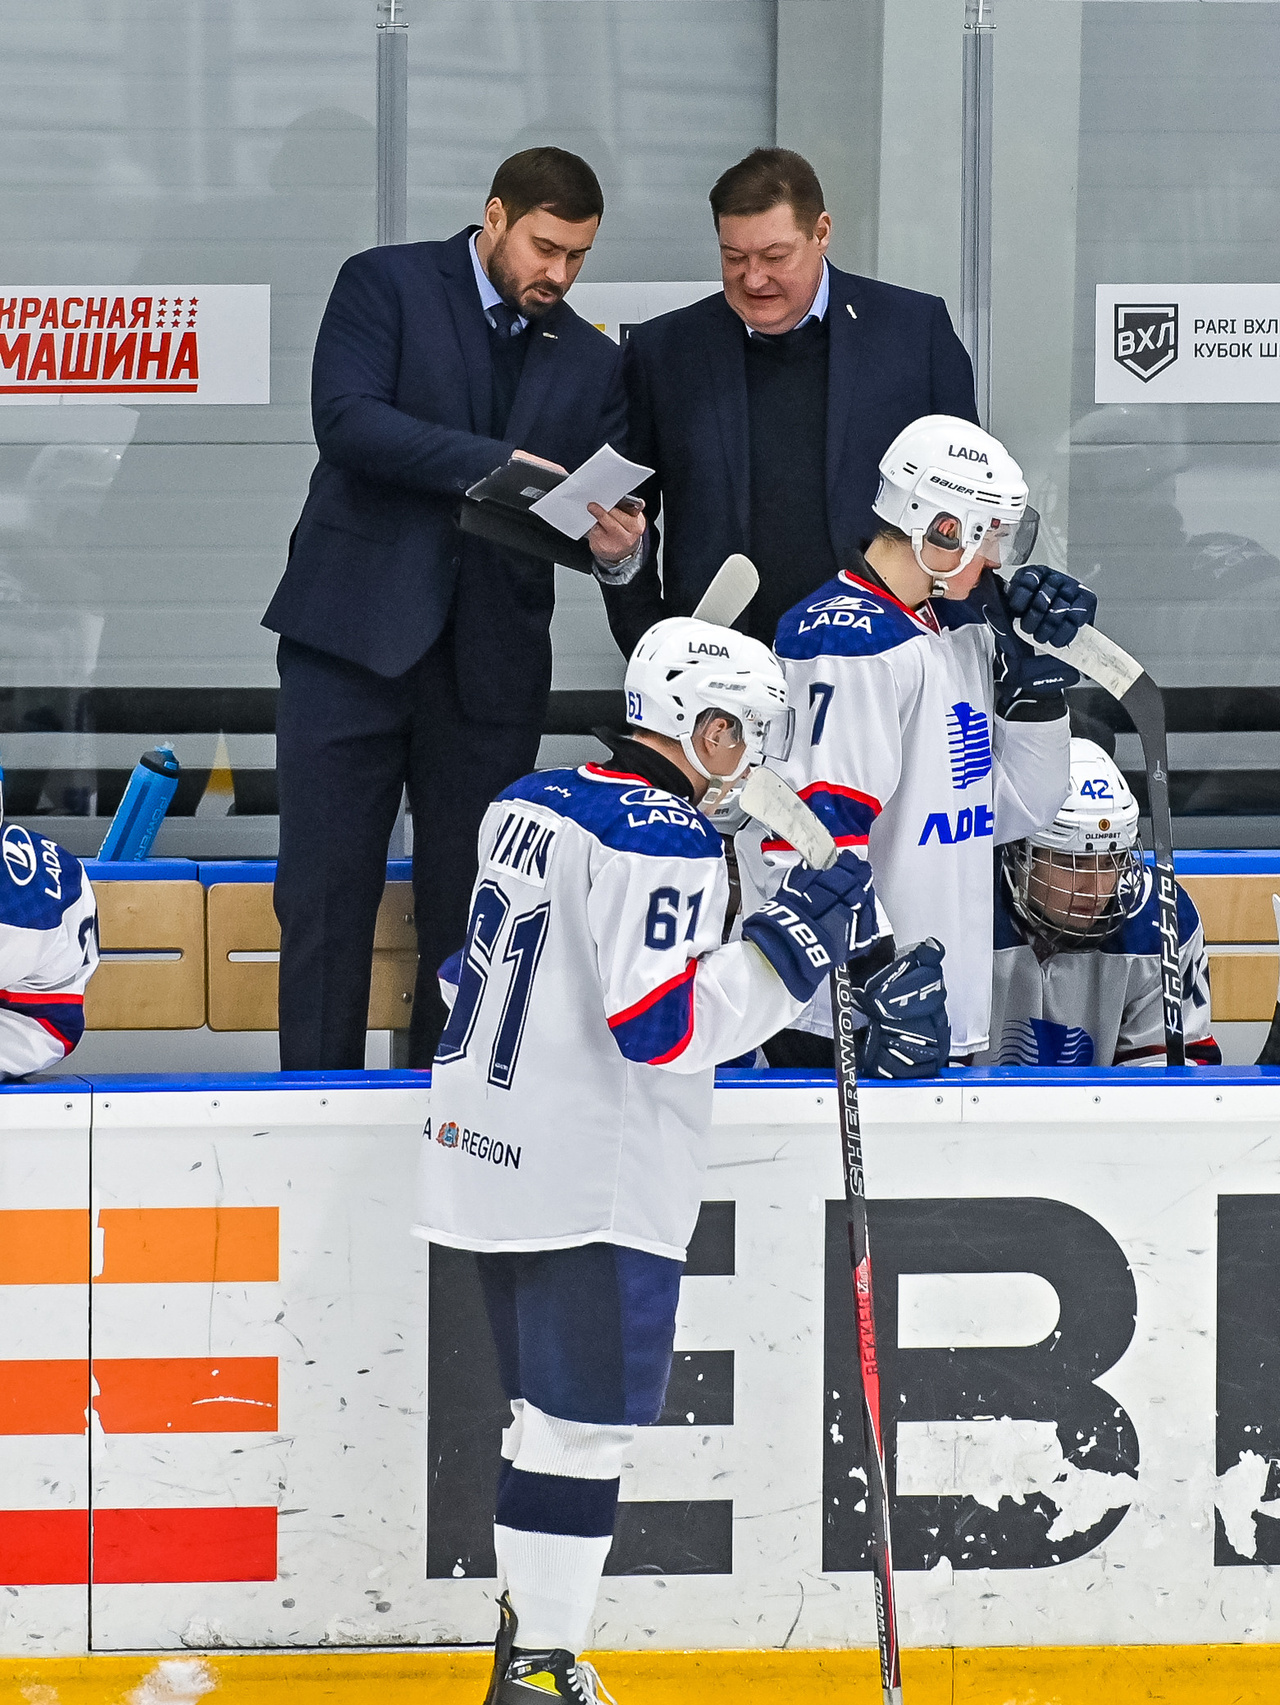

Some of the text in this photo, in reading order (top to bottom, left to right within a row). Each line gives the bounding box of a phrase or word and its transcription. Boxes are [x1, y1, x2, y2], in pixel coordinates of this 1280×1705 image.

[1117, 321, 1175, 357] ВХЛ
[1194, 319, 1278, 334] PARI ВХЛ
[1194, 343, 1280, 357] КУБОК Ш
[948, 445, 989, 465] LADA
[930, 475, 975, 495] BAUER
[798, 611, 872, 635] LADA
[688, 642, 730, 659] LADA
[627, 691, 643, 720] 61
[809, 681, 835, 746] 7
[1080, 779, 1113, 800] 42
[627, 810, 706, 838] LADA
[1086, 832, 1122, 840] OLIMPBET
[44, 838, 62, 900] LADA
[644, 886, 706, 951] 61
[757, 900, 832, 968] BAUE
[434, 878, 551, 1092] 61
[461, 1128, 522, 1170] REGION
